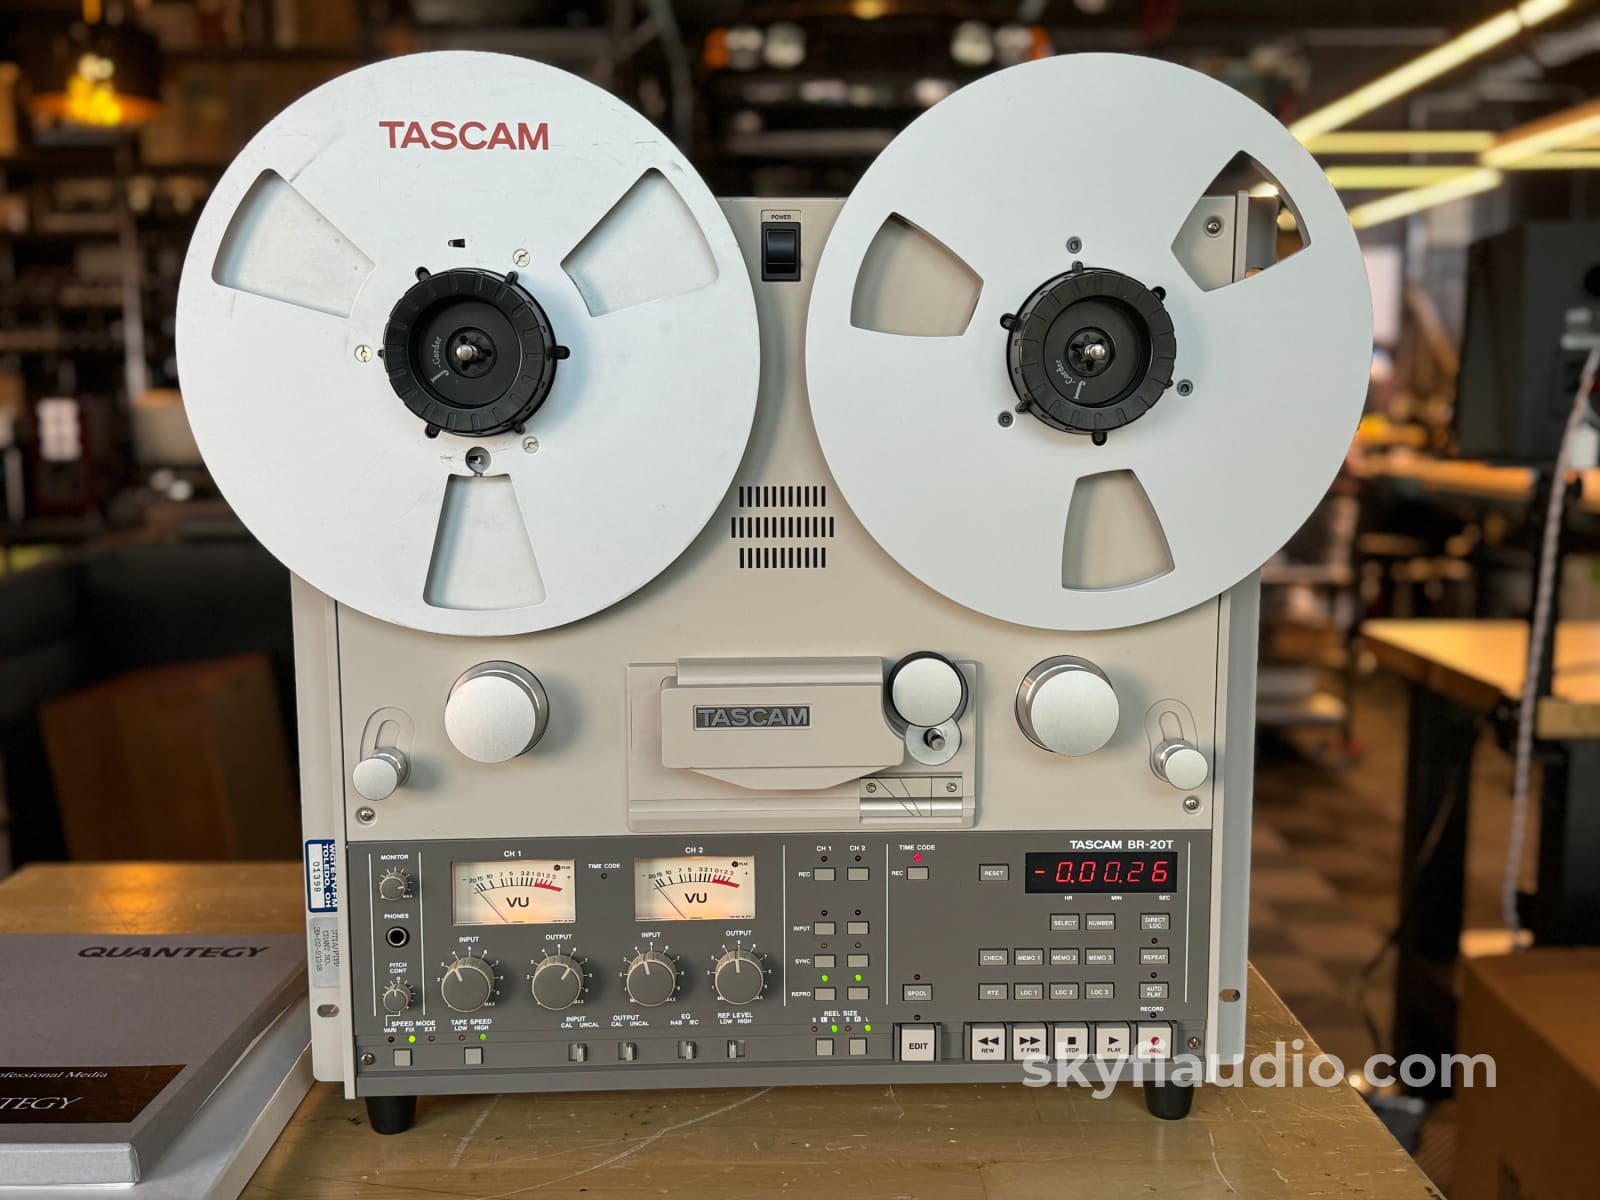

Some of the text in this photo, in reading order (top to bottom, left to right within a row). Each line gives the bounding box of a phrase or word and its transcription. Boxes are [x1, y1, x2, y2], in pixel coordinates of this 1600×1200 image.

[378, 121, 549, 150] TASCAM
[697, 707, 808, 727] TASCAM
[685, 846, 696, 854] CH
[1069, 840, 1174, 849] TASCAM BR-20T
[313, 861, 321, 893] 01398
[324, 892, 332, 908] OH
[506, 896, 530, 908] VU
[684, 892, 708, 904] VU
[78, 945, 271, 959] QUANTEGY
[909, 1042, 928, 1050] EDIT
